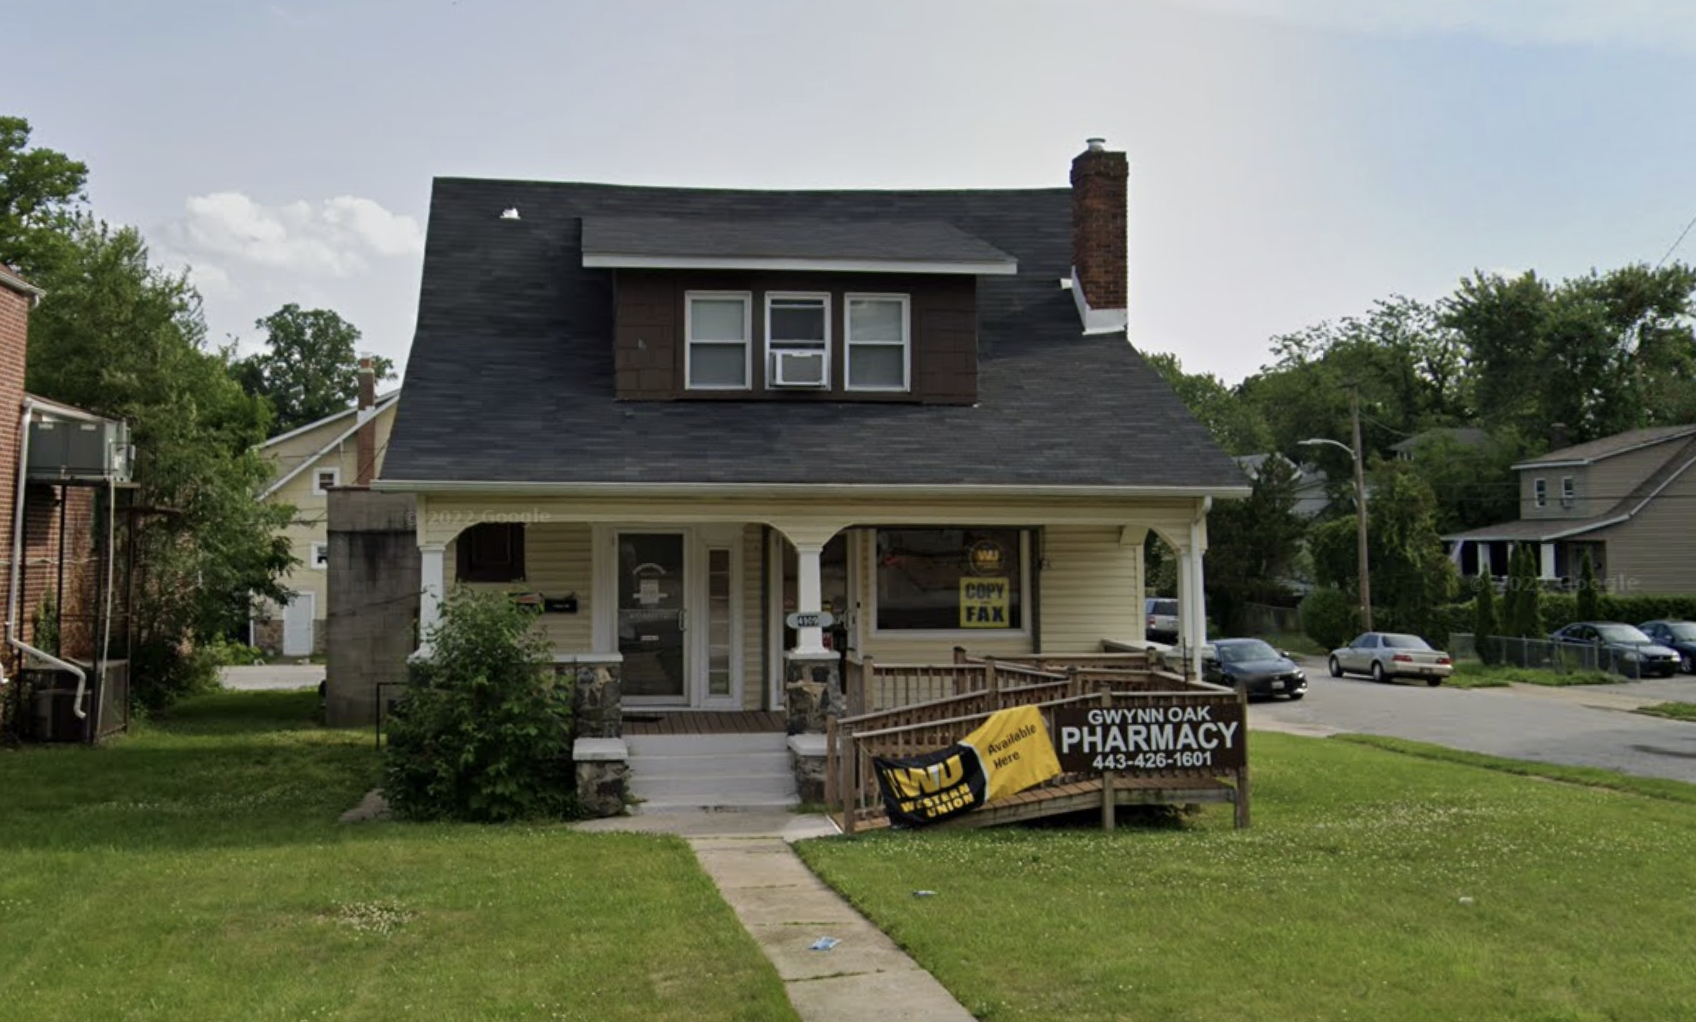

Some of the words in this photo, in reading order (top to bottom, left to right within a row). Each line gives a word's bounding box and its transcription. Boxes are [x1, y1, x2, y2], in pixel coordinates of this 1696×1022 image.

[965, 582, 1004, 599] COPY
[966, 606, 1004, 622] FAX
[1088, 708, 1164, 725] GWYNN
[1168, 705, 1211, 723] OAK
[987, 723, 1037, 756] Available
[1061, 721, 1238, 754] PHARMACY
[993, 751, 1020, 769] Here
[1092, 751, 1212, 769] 443-426-1601
[892, 754, 963, 798] WU
[926, 792, 975, 818] UNION
